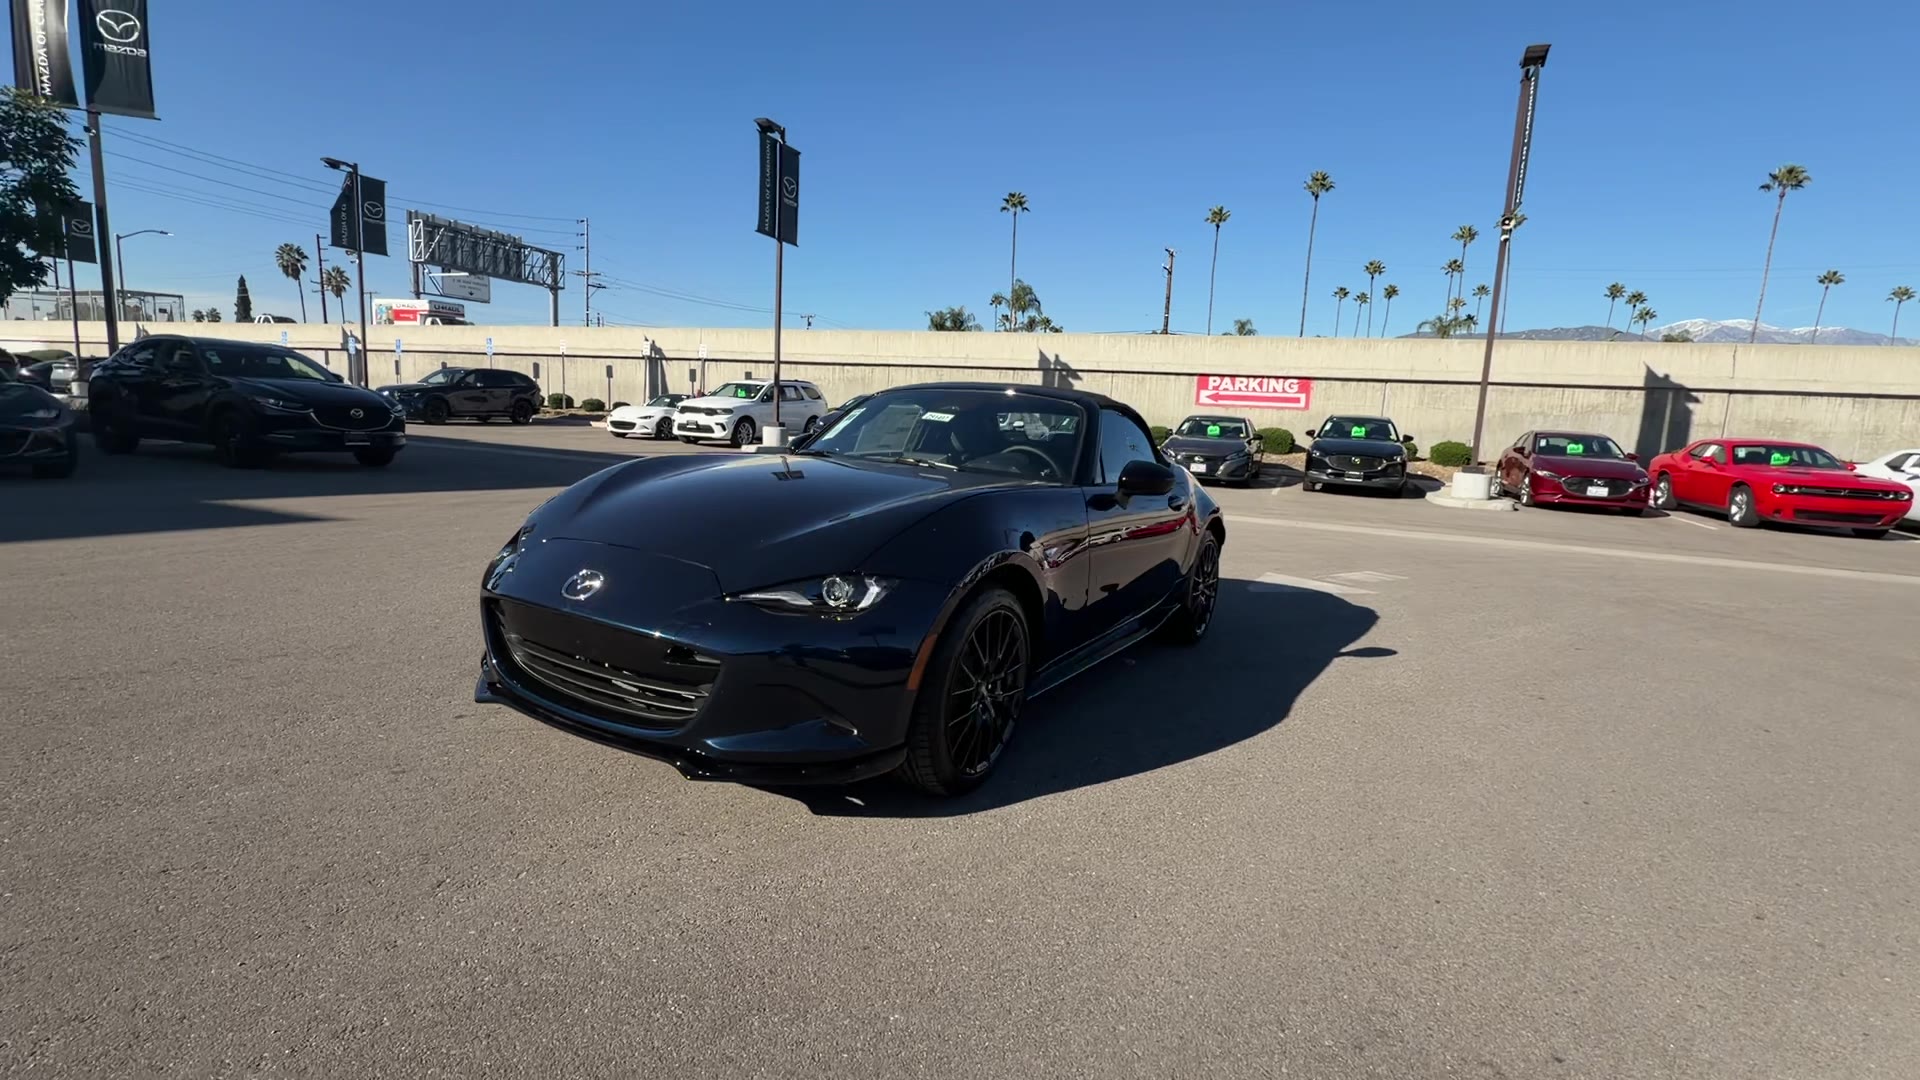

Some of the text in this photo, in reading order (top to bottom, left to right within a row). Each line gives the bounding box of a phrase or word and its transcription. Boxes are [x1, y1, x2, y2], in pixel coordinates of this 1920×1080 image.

[36, 29, 46, 45] OF
[37, 48, 52, 96] MAZDA
[1208, 376, 1299, 393] PARKING
